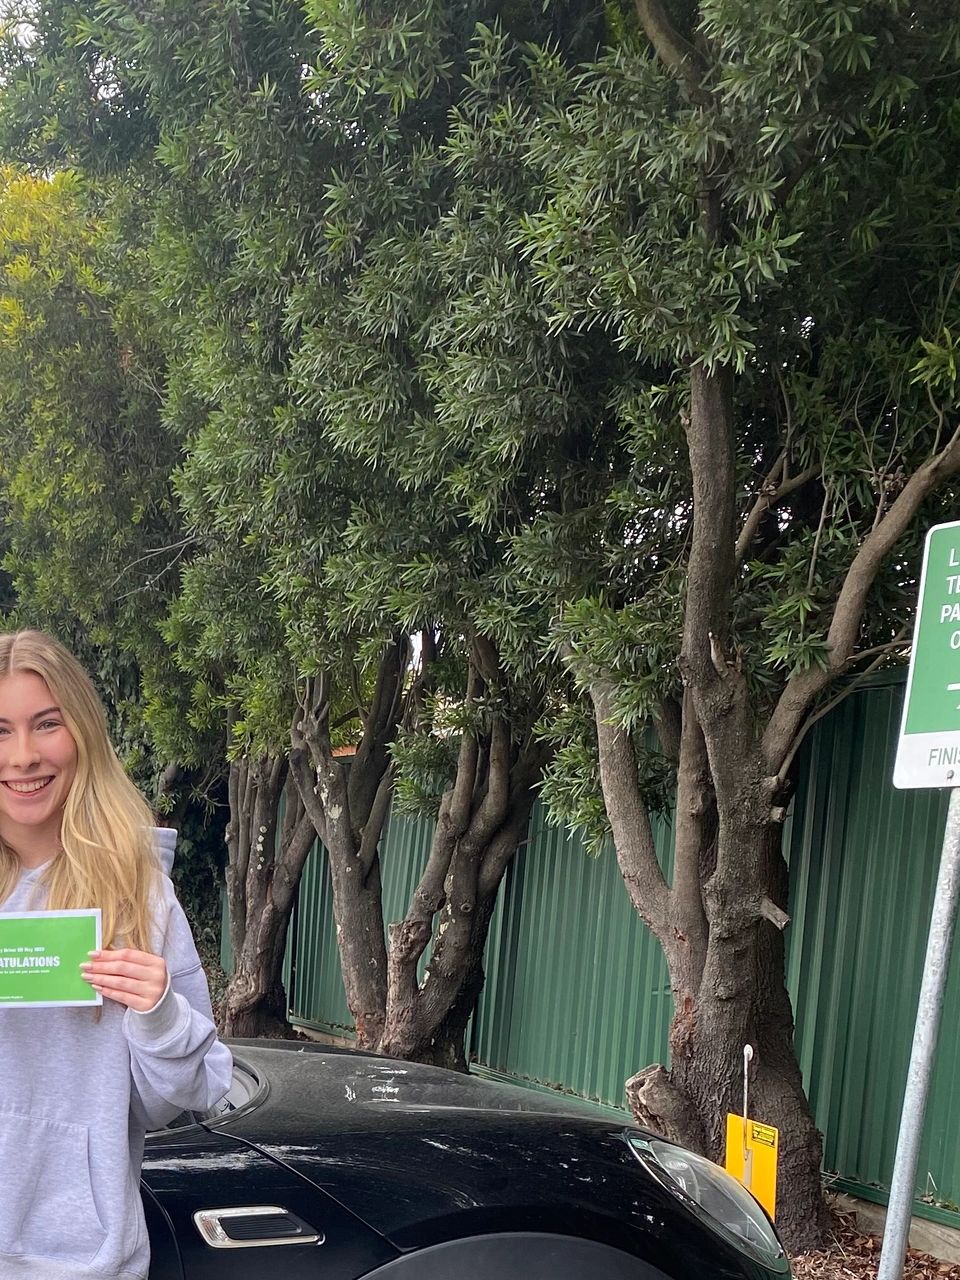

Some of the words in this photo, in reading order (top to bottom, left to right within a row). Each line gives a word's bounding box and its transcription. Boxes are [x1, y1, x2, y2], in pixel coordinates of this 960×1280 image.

[940, 603, 960, 624] PA
[950, 630, 960, 650] O
[928, 747, 960, 766] FINI
